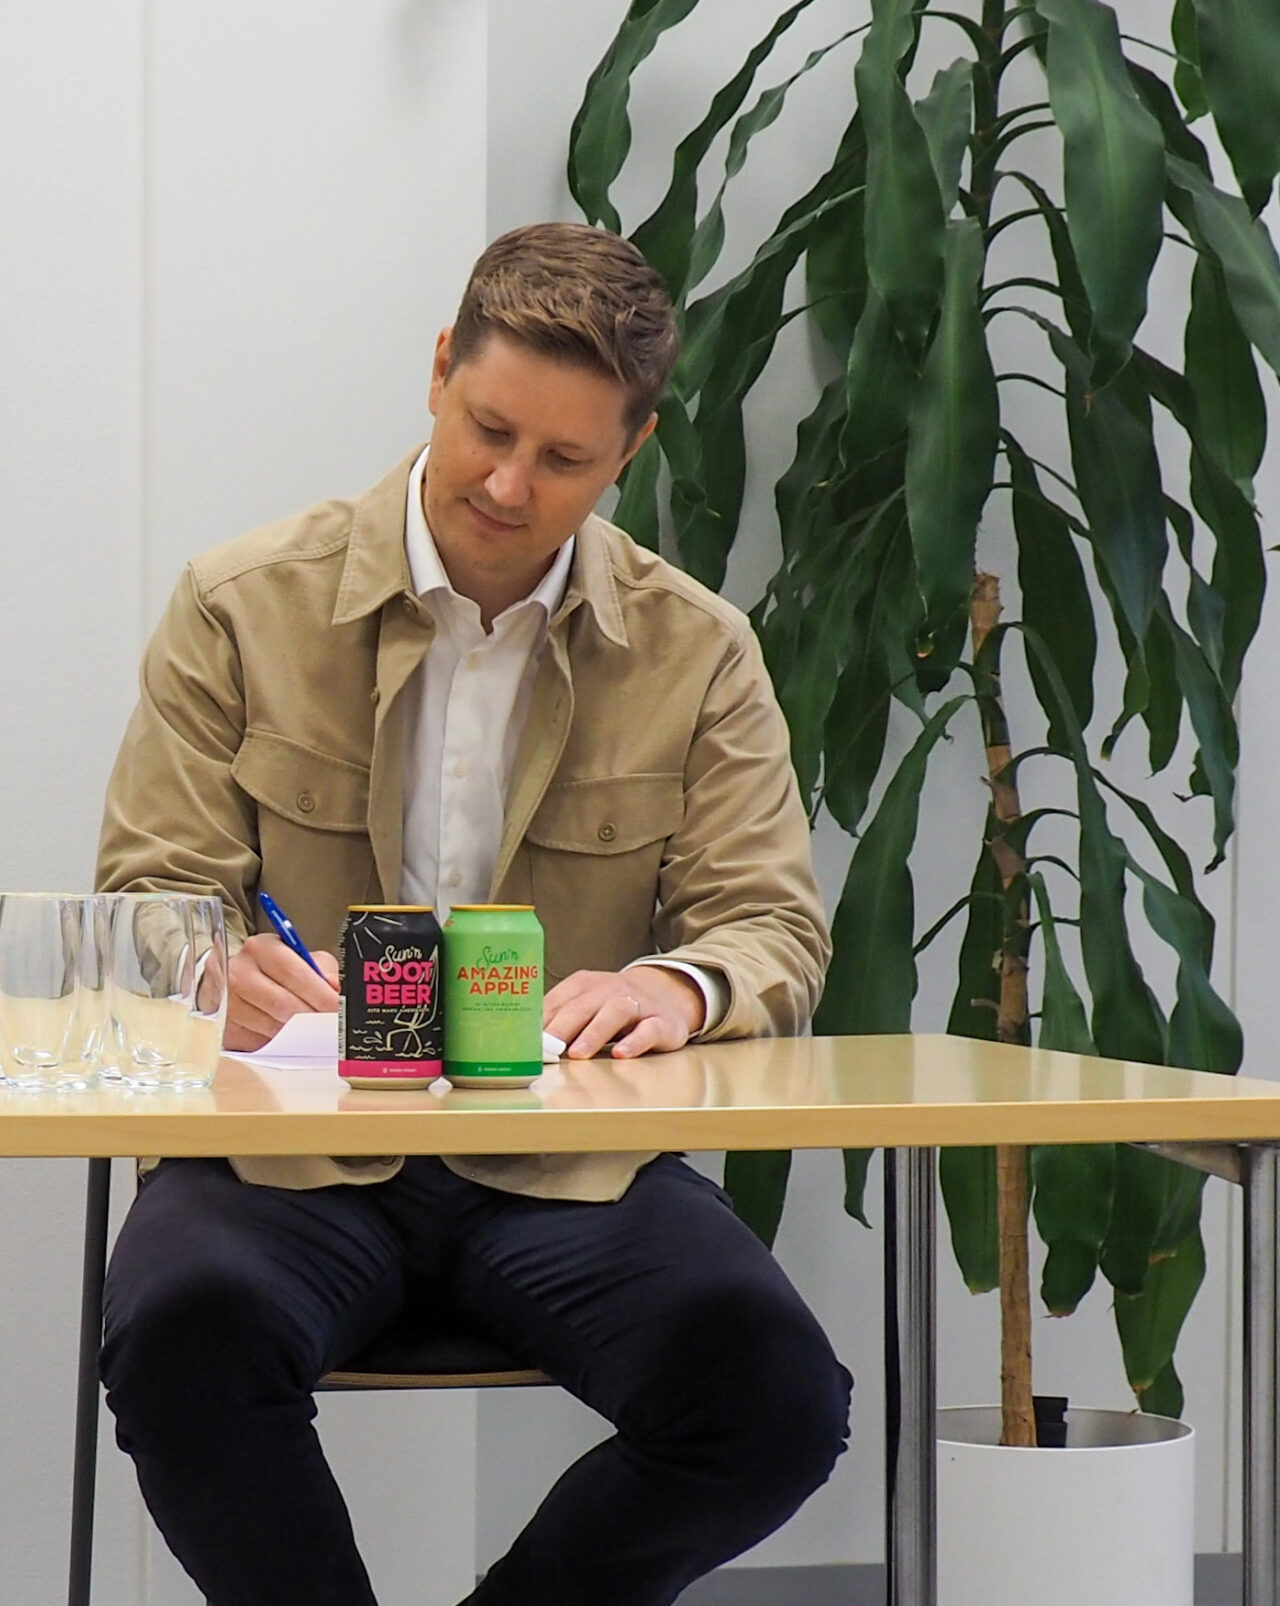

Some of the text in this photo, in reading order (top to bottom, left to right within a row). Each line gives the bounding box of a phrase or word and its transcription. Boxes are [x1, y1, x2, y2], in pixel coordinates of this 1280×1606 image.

[363, 961, 434, 983] ROOT
[457, 966, 538, 980] AMAZING
[366, 984, 432, 1005] BEER
[469, 981, 530, 995] APPLE
